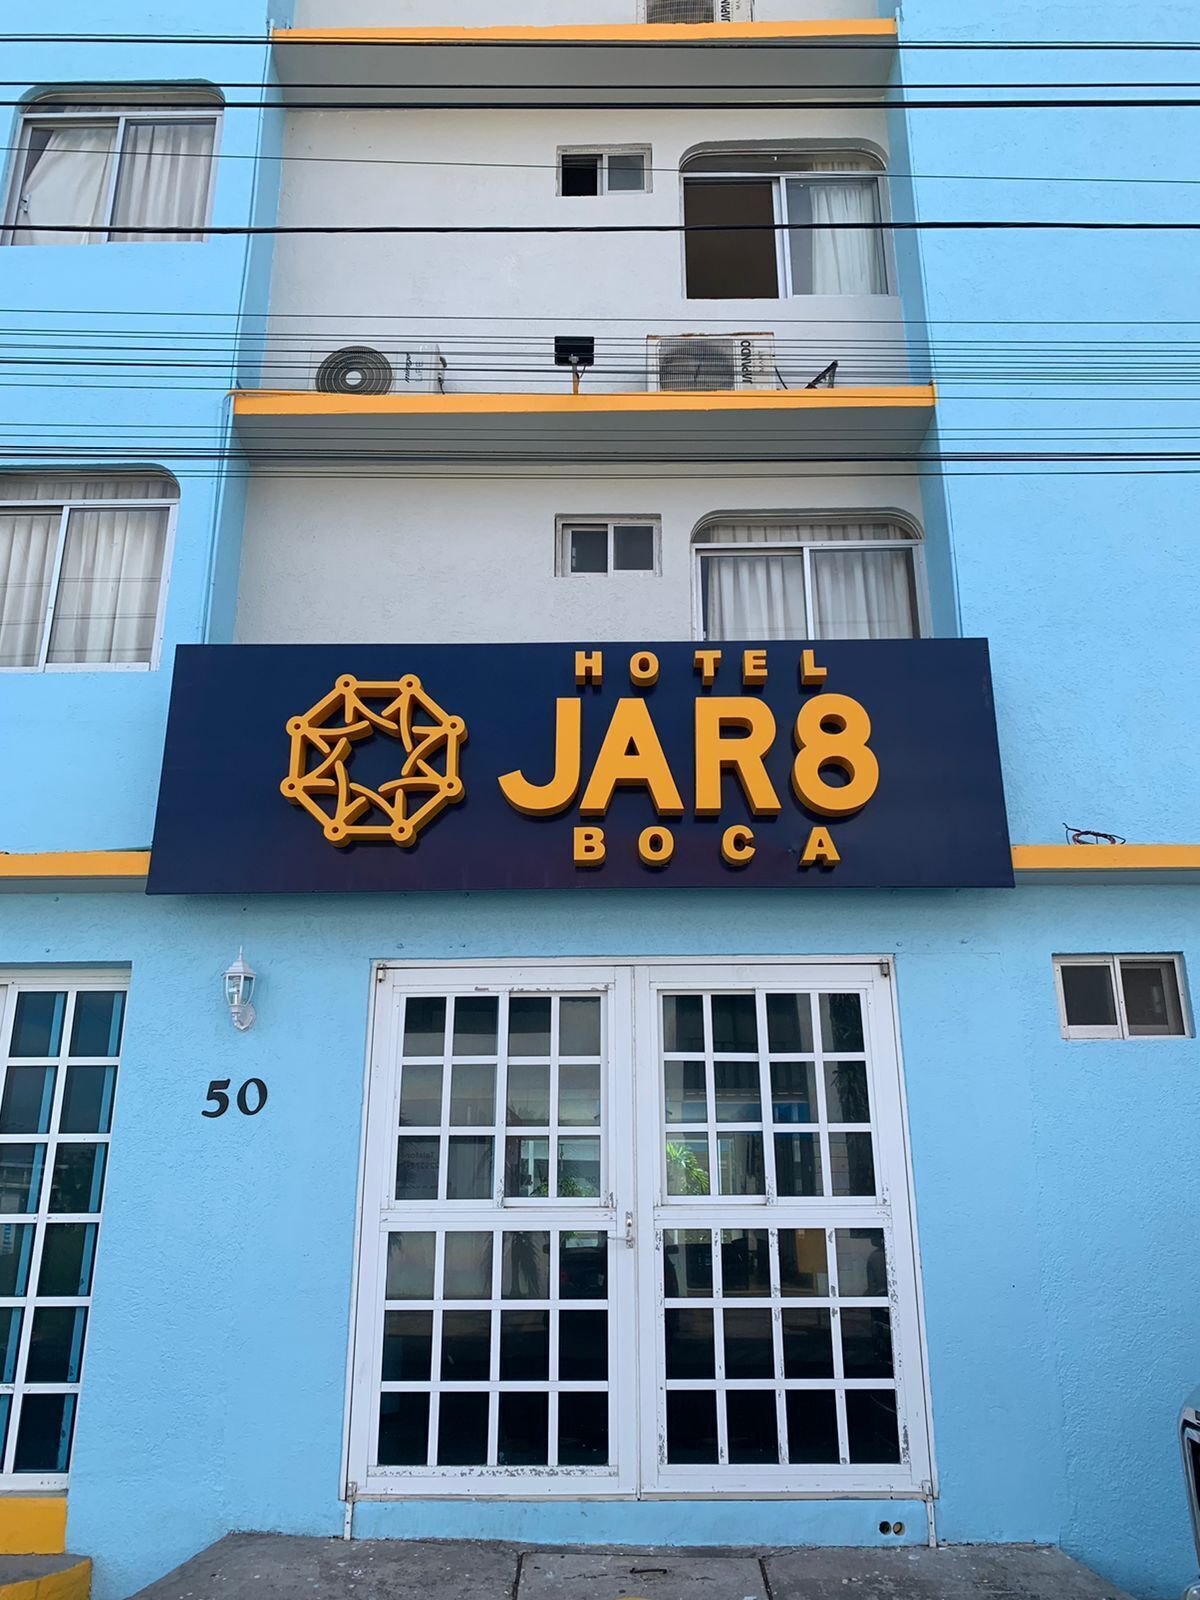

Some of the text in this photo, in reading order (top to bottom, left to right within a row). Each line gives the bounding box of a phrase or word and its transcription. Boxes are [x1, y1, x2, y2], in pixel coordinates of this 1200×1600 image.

[574, 649, 828, 687] HOTEL
[497, 692, 880, 817] JAR8
[573, 824, 841, 867] BOCA
[201, 1077, 268, 1118] 50
